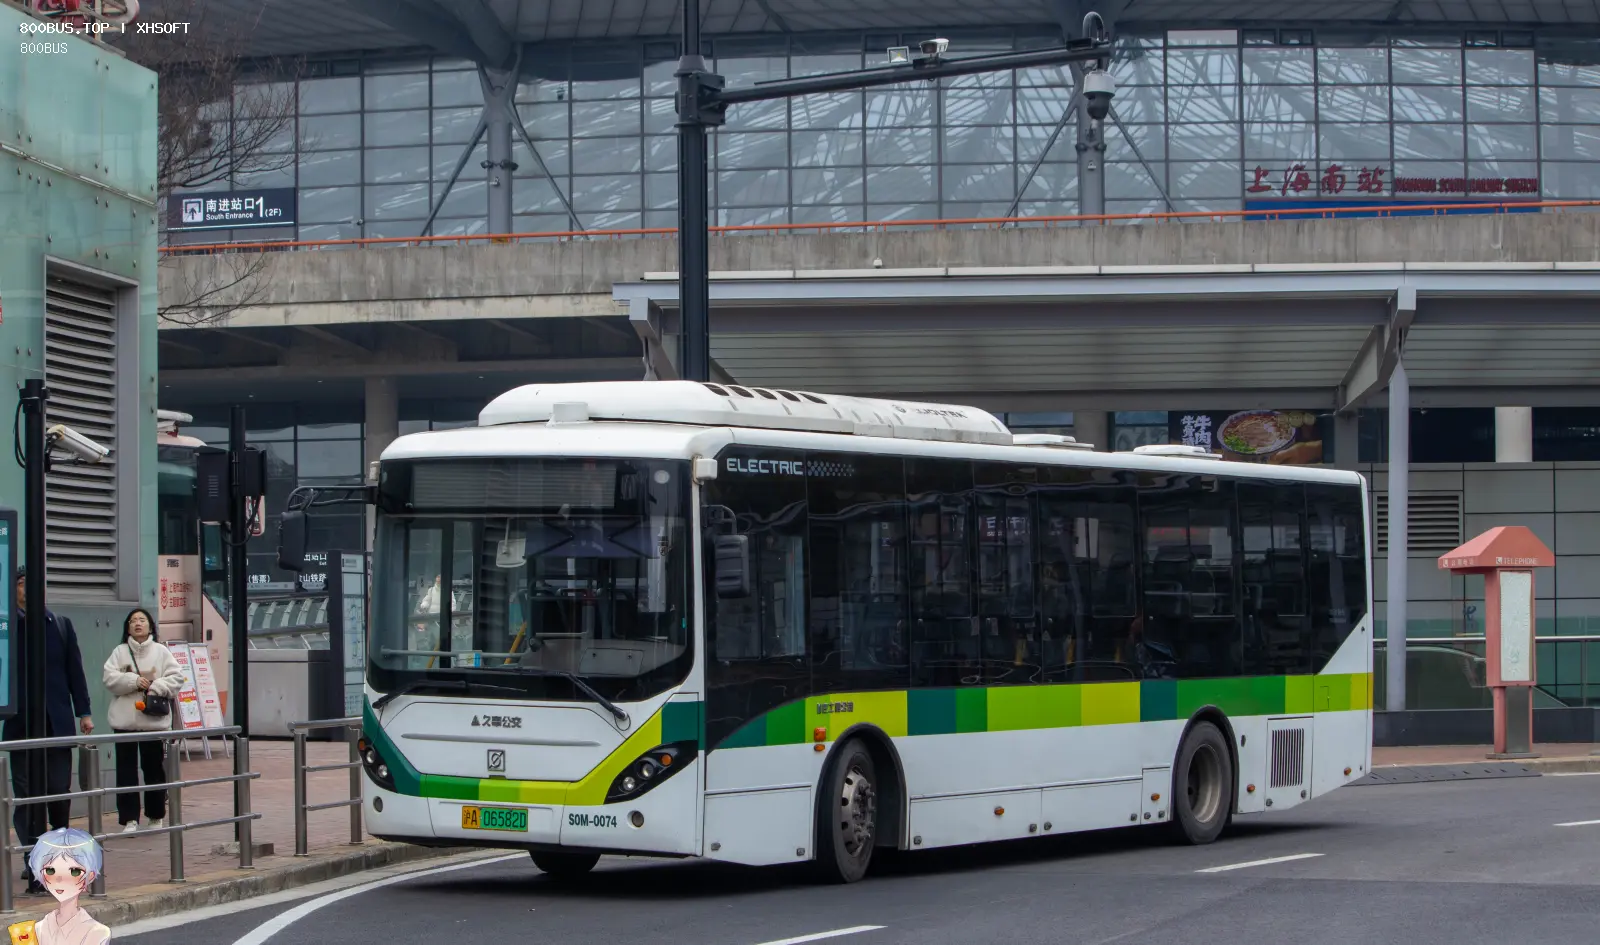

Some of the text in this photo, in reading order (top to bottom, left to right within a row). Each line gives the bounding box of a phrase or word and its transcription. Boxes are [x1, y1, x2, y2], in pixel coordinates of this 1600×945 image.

[1246, 163, 1385, 196] 上海南站
[205, 211, 254, 221] South Entrance
[264, 208, 282, 218] (2F)
[726, 457, 804, 476] ELECTRIC
[1503, 557, 1538, 565] TELEPHONE
[483, 810, 527, 828] 06582D
